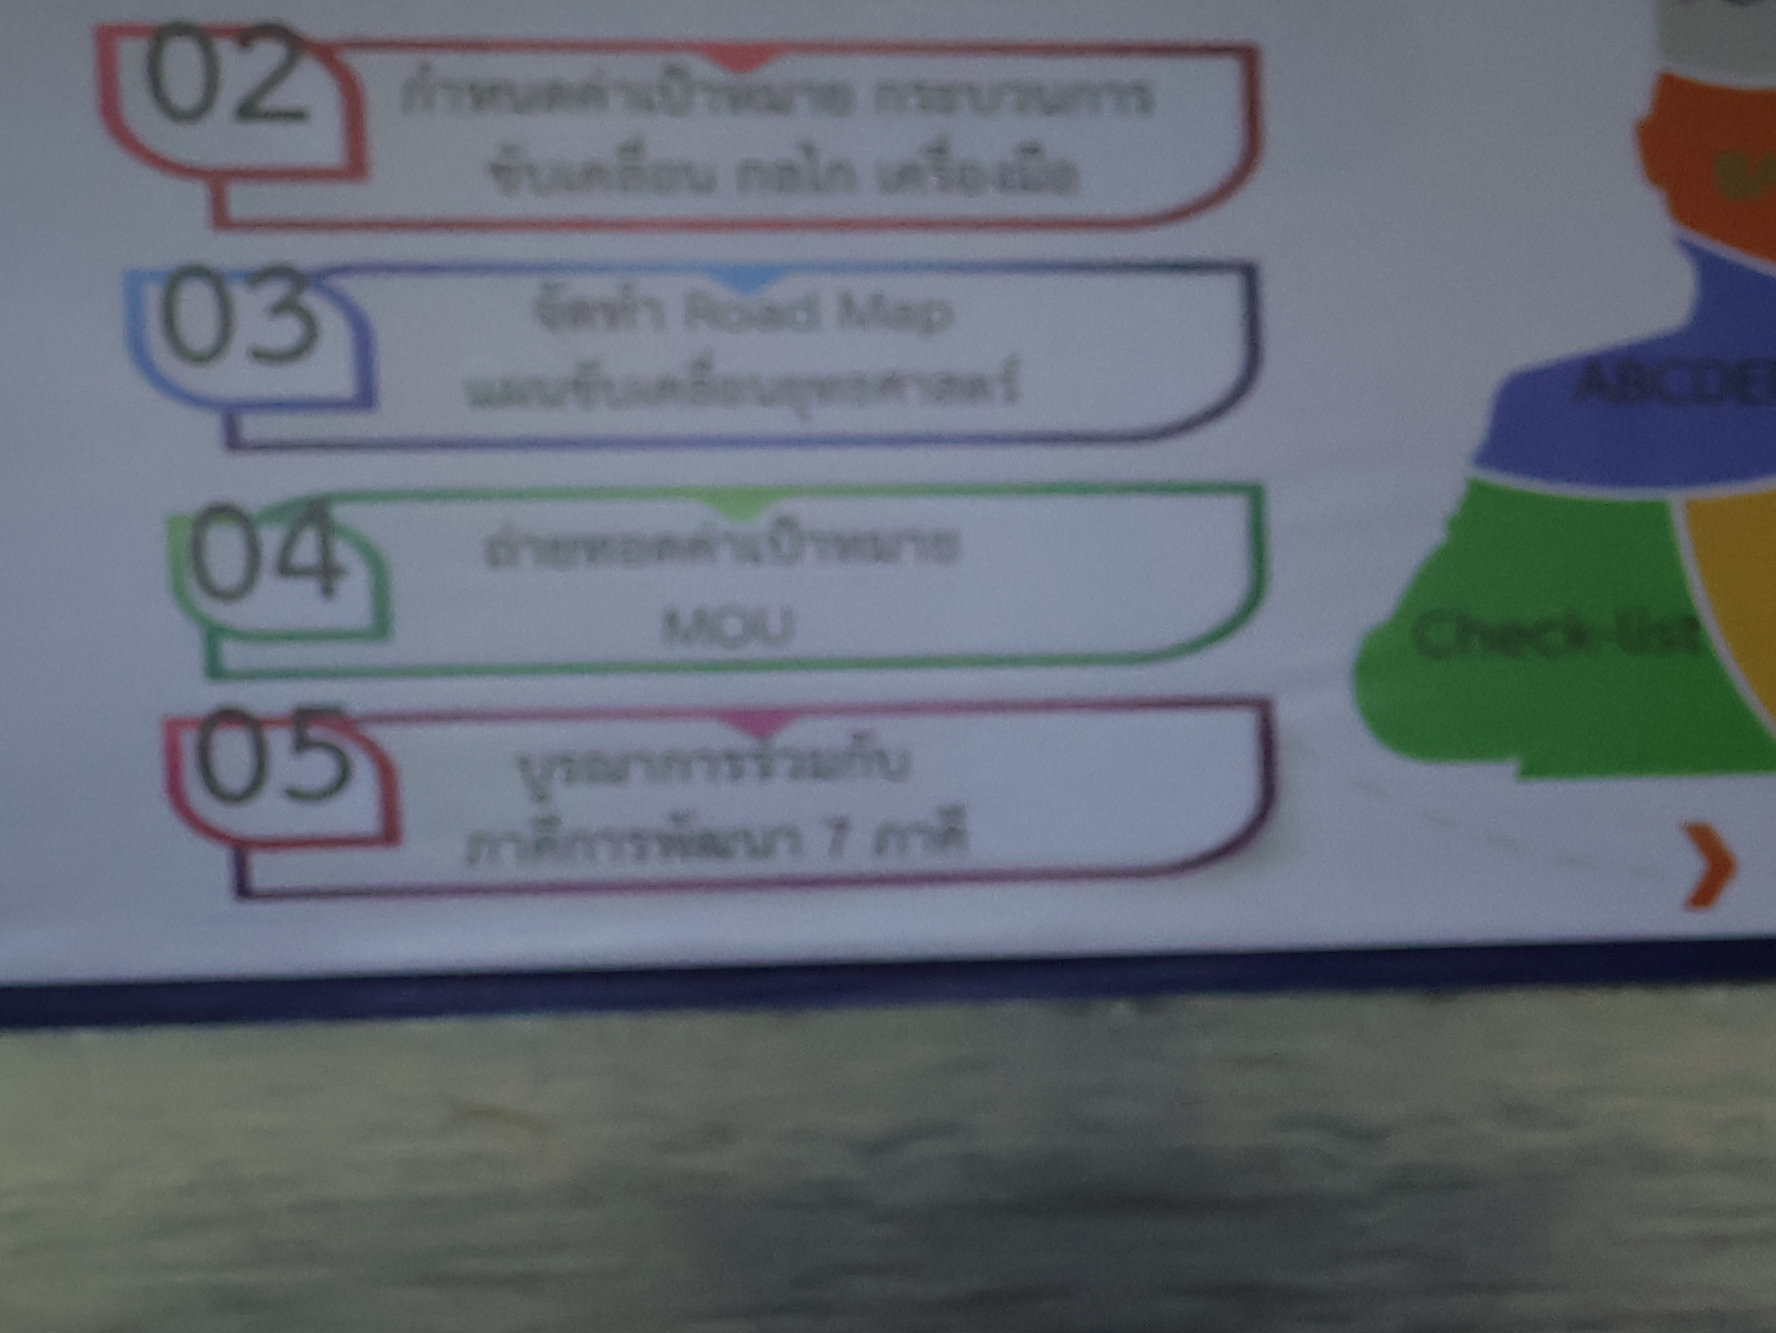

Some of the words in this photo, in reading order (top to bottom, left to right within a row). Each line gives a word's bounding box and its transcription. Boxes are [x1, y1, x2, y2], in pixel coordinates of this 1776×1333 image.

[146, 20, 310, 124] 02
[871, 78, 1156, 117] กระบวนการ
[735, 138, 861, 197] กลไก
[873, 134, 1081, 198] เครื่องมือ
[161, 262, 320, 366] 03
[534, 282, 668, 334] จัดทำ
[681, 290, 823, 334] Road
[838, 287, 956, 339] Map
[190, 502, 348, 602] 04
[661, 604, 797, 650] MOU
[197, 702, 352, 806] 05
[826, 813, 853, 859] 7
[872, 801, 971, 859] ภาคี
